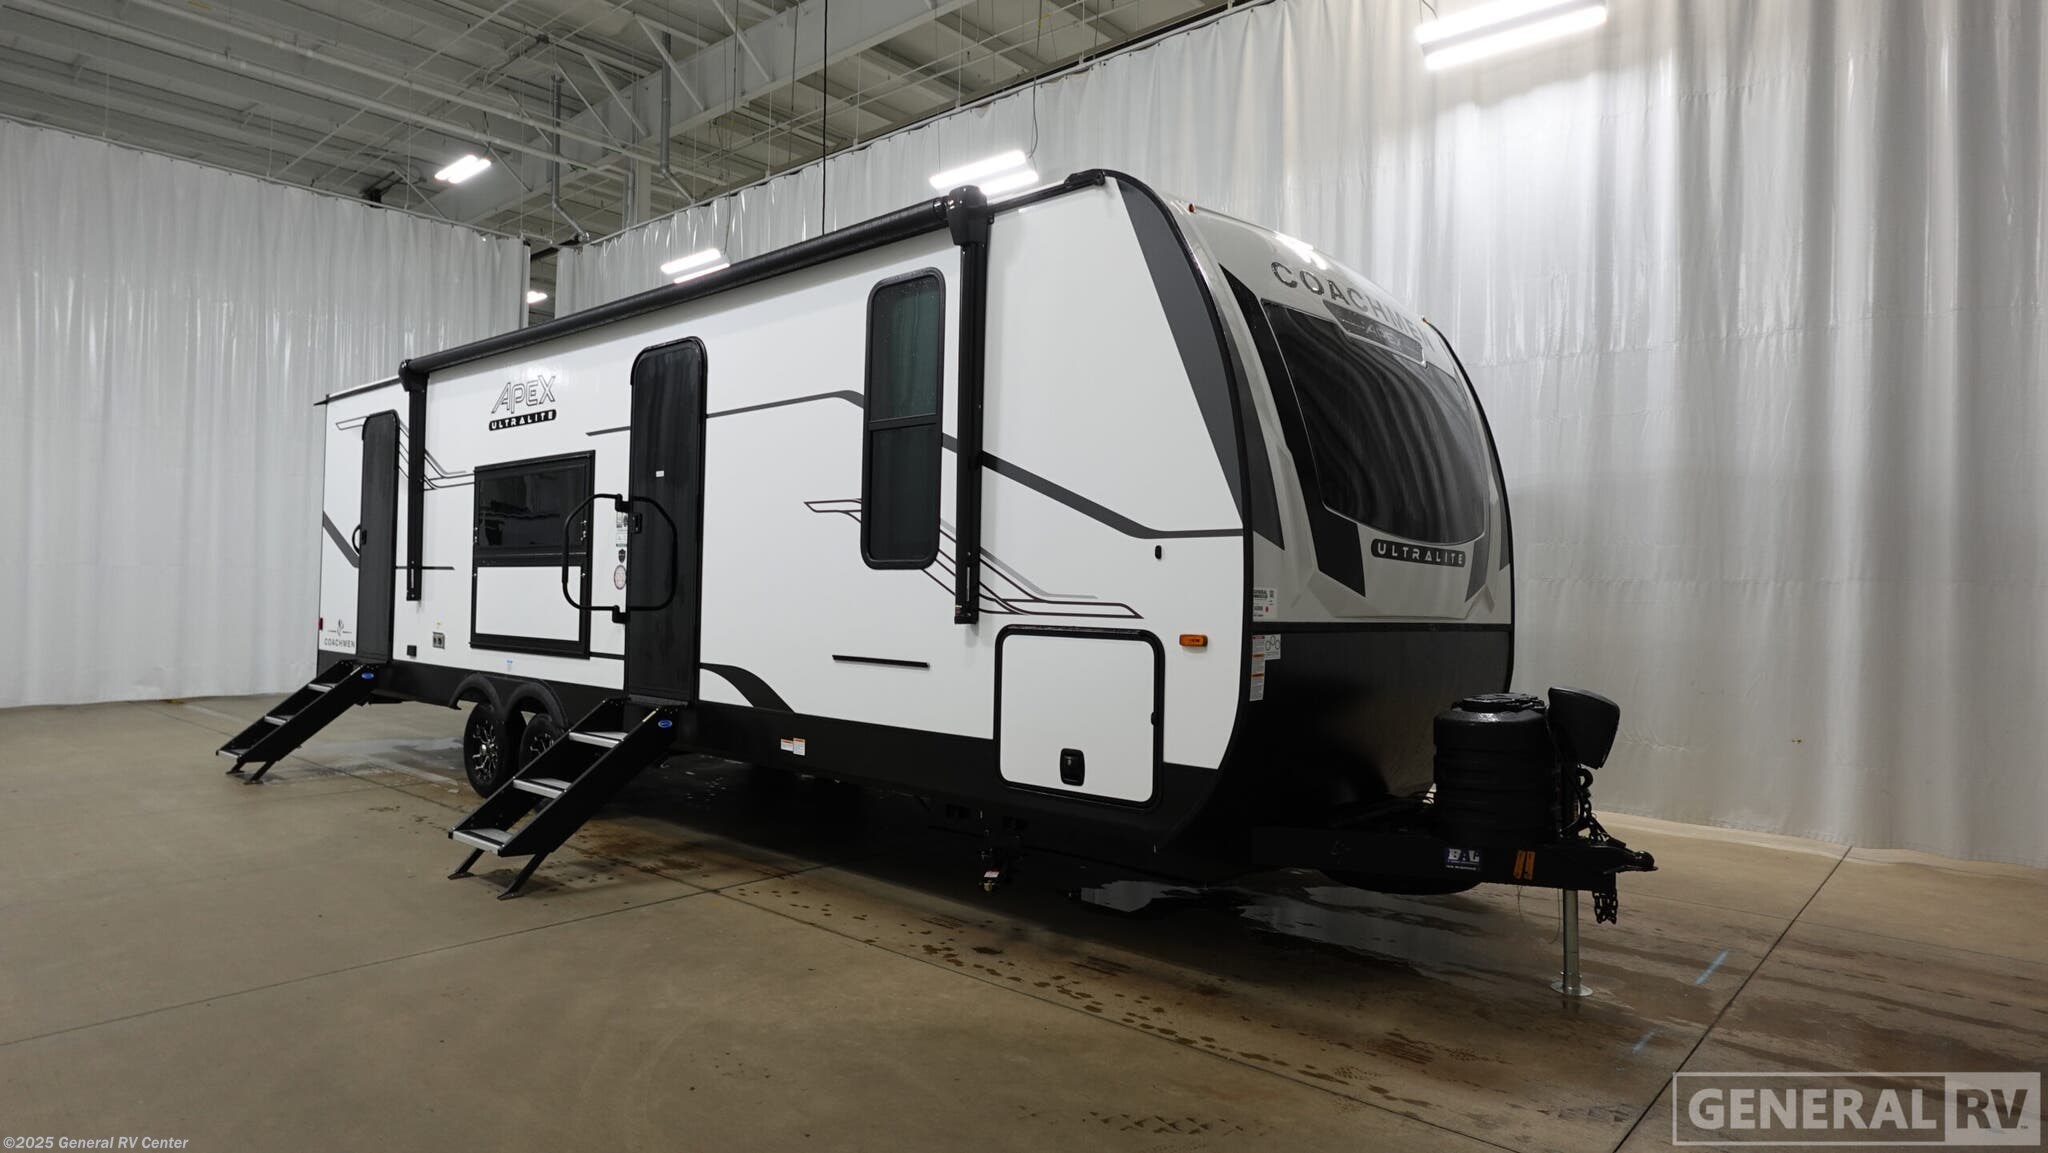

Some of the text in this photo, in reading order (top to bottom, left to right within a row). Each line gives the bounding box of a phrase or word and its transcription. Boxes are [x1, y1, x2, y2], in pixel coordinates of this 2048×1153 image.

[491, 375, 556, 414] APEX
[490, 411, 554, 429] ULTRALITE
[1377, 542, 1464, 564] ULTRALITE
